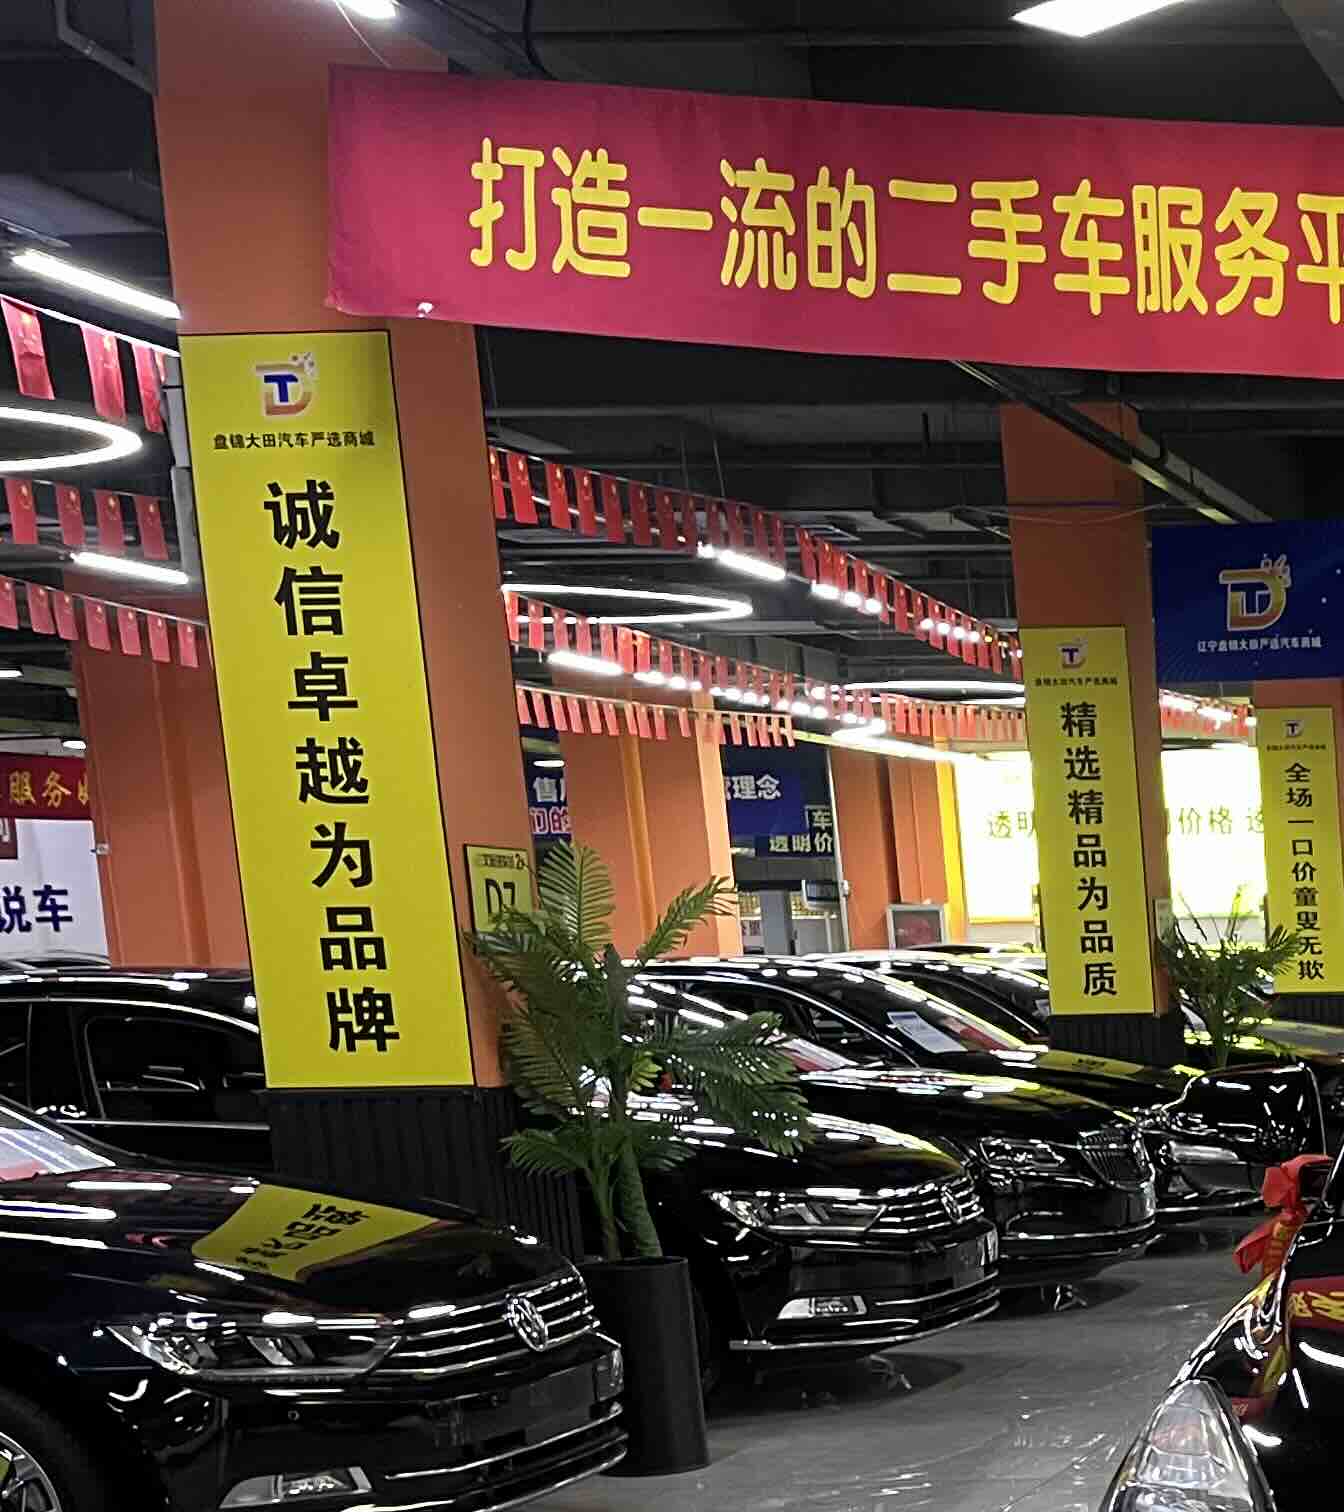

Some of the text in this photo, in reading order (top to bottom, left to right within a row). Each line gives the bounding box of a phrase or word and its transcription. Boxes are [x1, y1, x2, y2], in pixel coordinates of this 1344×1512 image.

[263, 479, 400, 1053] 诚信卓越为品牌
[1060, 702, 1117, 997] 精选精品为品质
[1167, 804, 1233, 835] 价格
